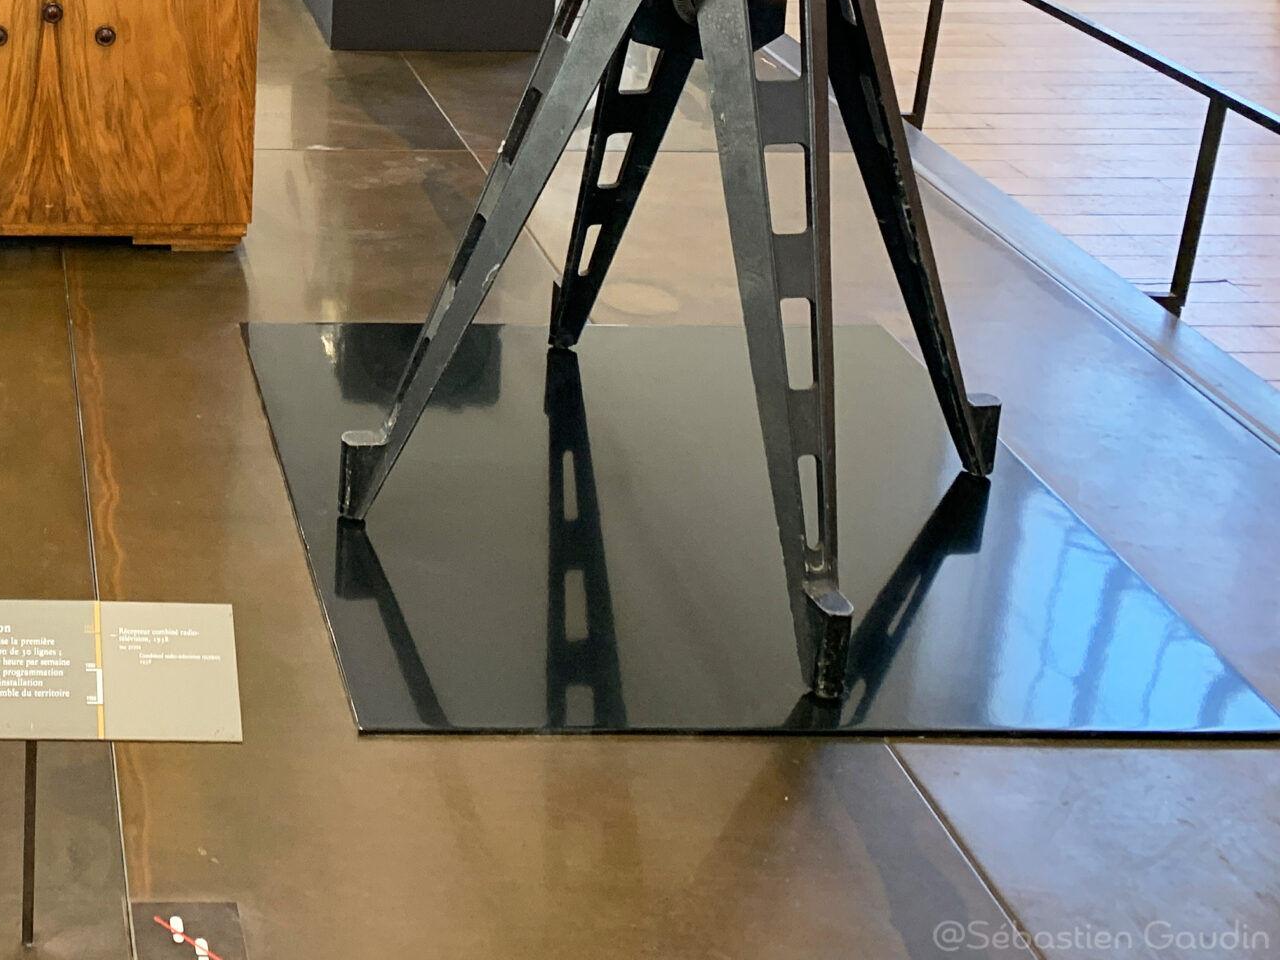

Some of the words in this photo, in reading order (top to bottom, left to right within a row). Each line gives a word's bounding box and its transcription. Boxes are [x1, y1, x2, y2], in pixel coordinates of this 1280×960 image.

[10, 637, 18, 645] la
[20, 637, 56, 647] première
[9, 647, 19, 656] de
[34, 647, 57, 657] lignes
[2, 657, 24, 666] heure
[25, 658, 38, 667] par
[40, 658, 71, 666] semaine
[2, 668, 64, 678] programmation
[21, 688, 32, 697] du
[34, 688, 70, 697] territoire
